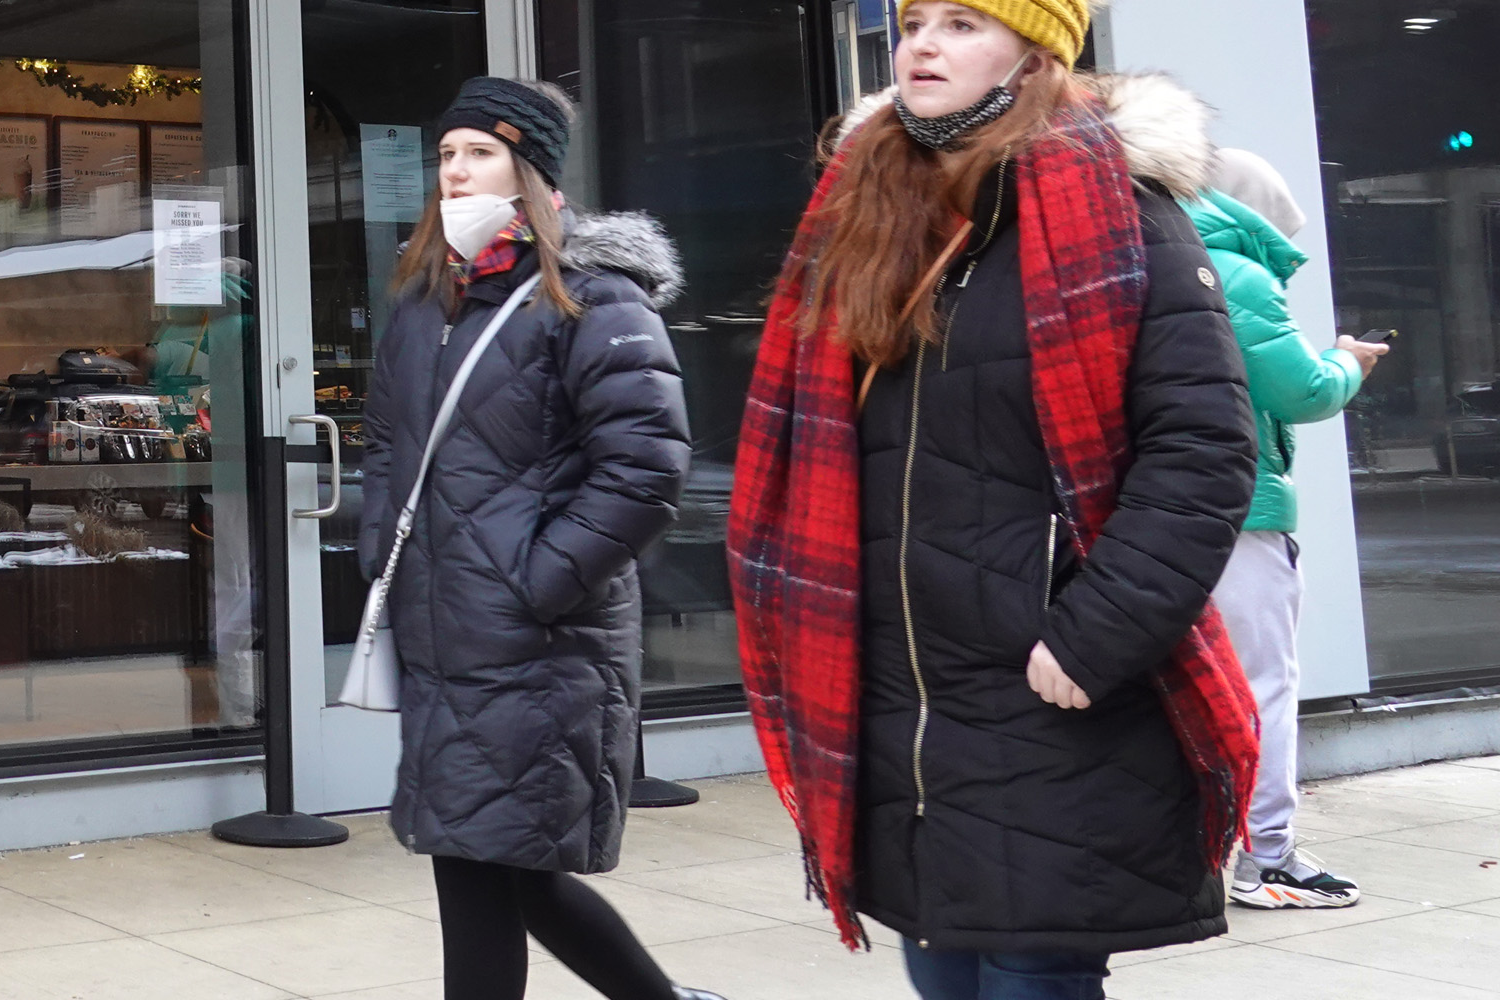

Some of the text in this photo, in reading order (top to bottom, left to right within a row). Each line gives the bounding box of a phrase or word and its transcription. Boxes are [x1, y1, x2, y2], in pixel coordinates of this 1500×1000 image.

[173, 210, 201, 219] SORRY WE
[171, 219, 191, 227] MISSED
